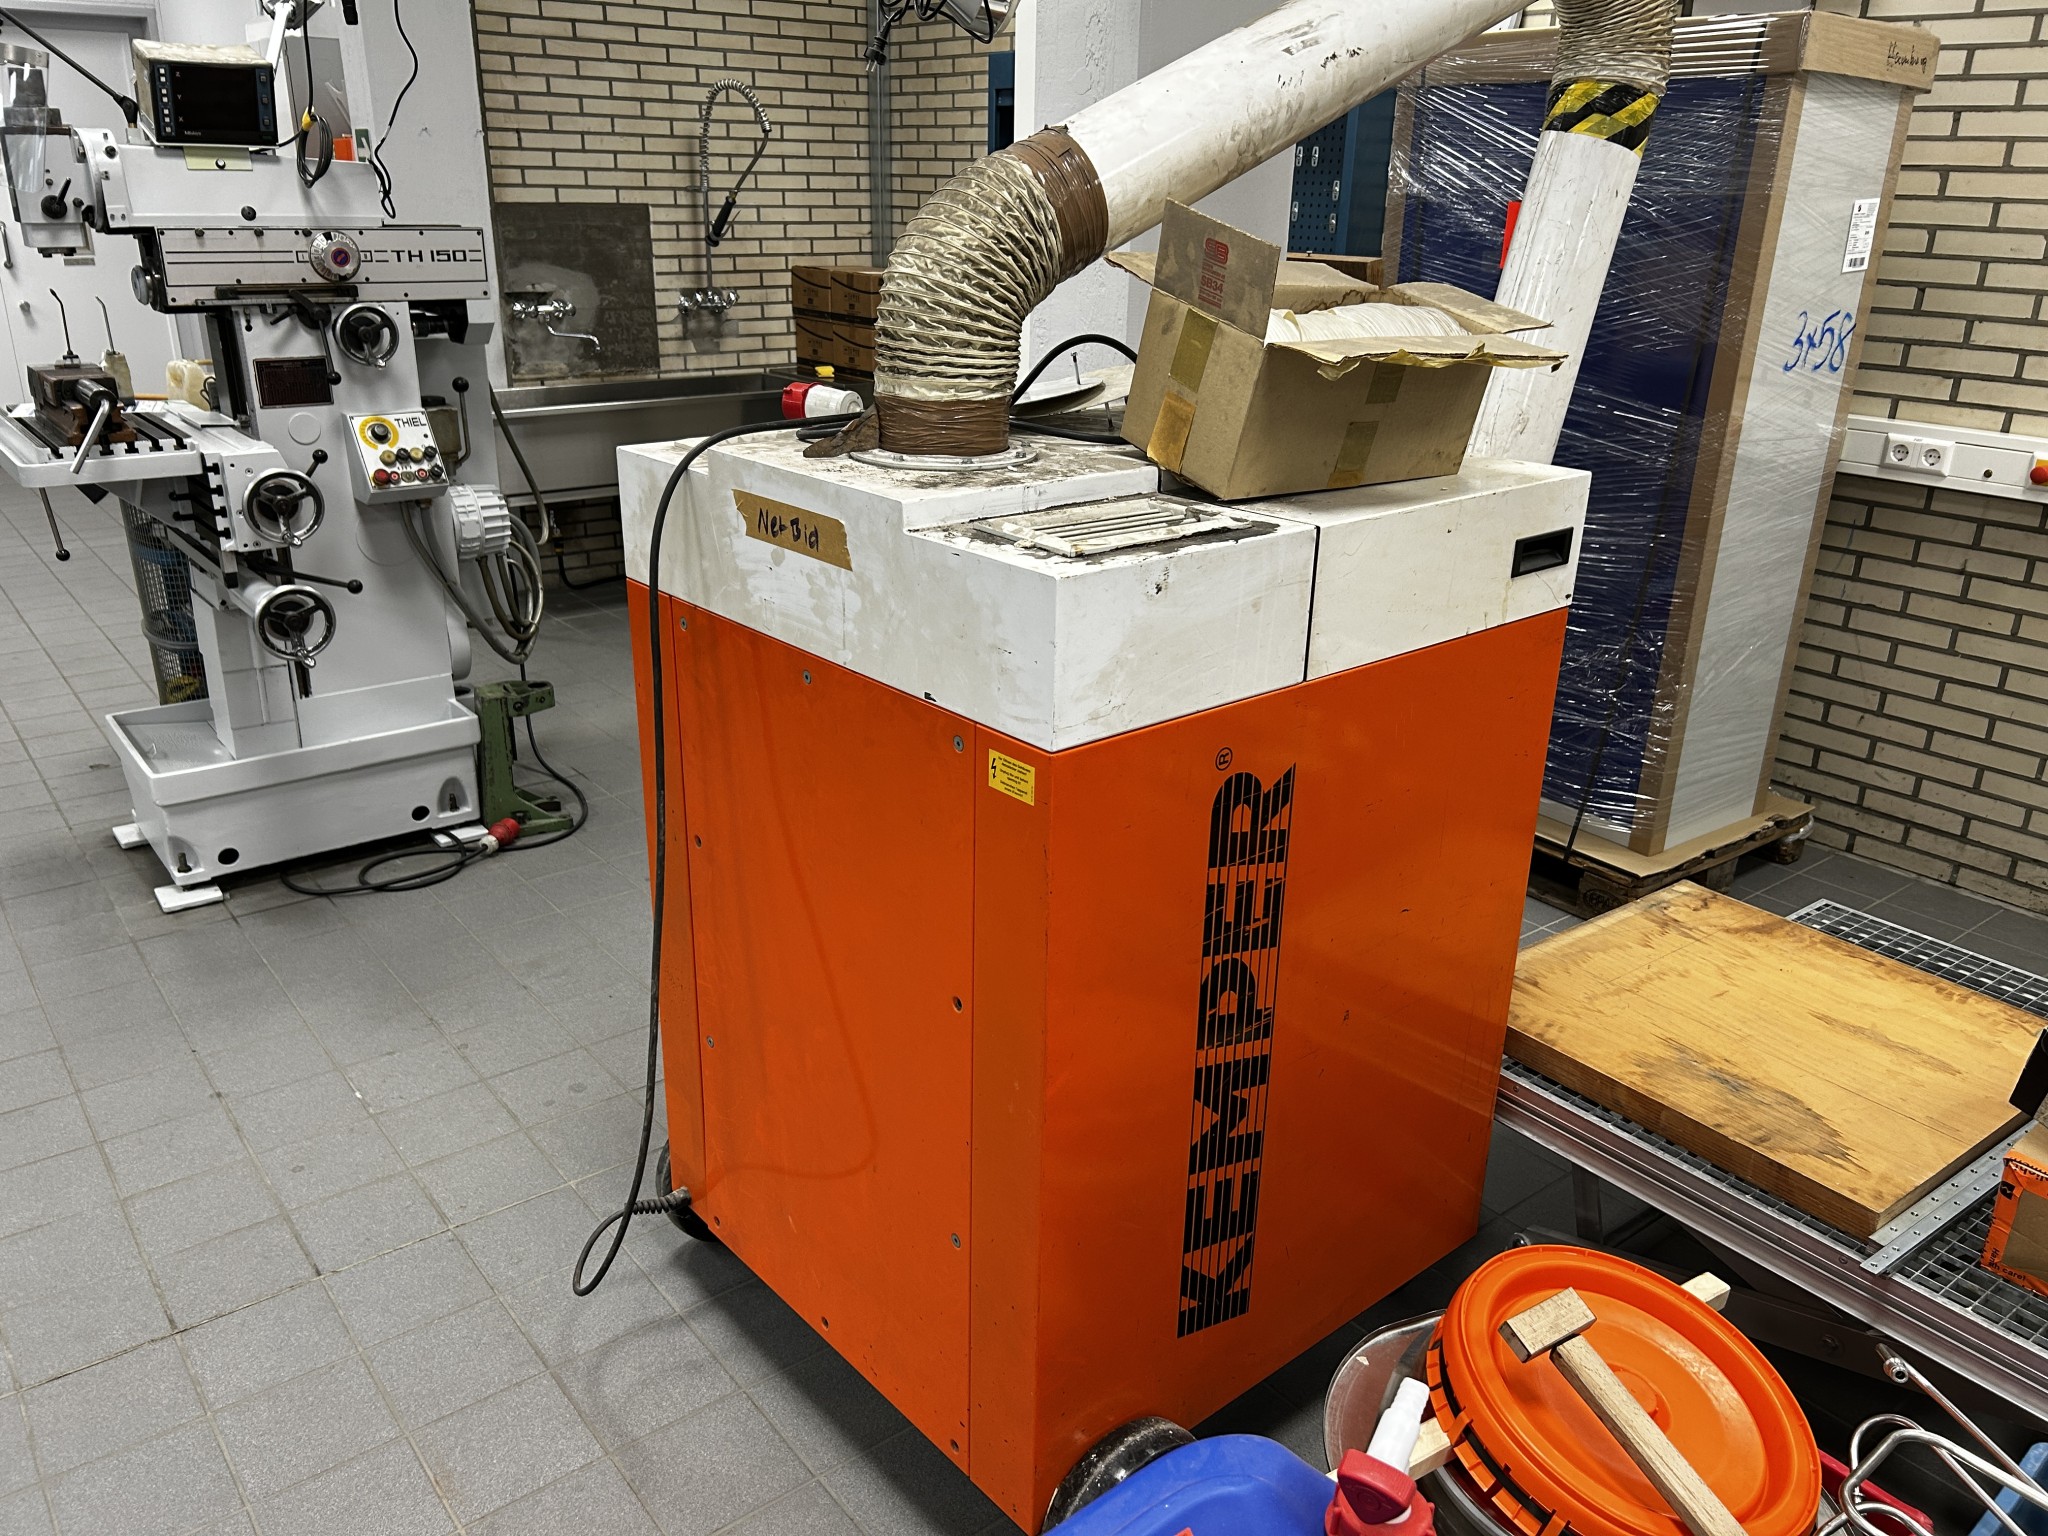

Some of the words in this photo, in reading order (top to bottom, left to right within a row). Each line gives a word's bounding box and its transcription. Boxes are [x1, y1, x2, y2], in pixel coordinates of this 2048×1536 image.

[391, 250, 424, 262] TH
[430, 250, 467, 262] 150
[394, 417, 427, 428] THIEL
[1177, 762, 1296, 1339] KEMPER
